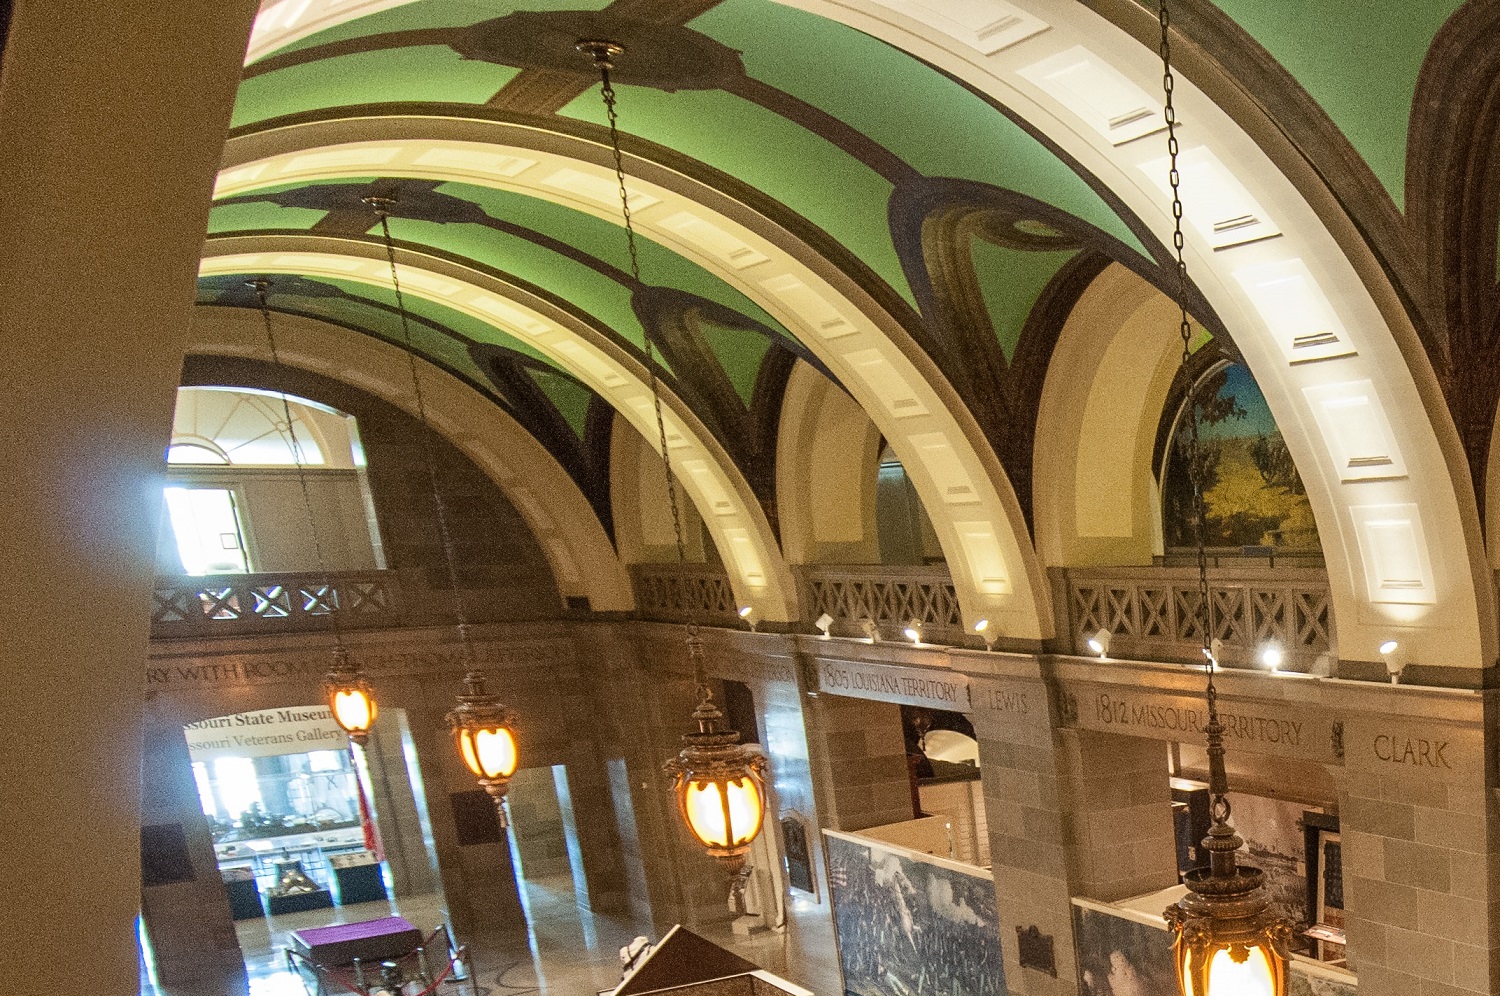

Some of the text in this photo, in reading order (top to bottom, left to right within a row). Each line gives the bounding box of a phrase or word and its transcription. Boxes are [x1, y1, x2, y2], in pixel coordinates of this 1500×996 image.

[176, 663, 239, 681] WITH
[824, 664, 850, 689] 1805
[850, 670, 901, 695] LOUISIANA
[901, 677, 958, 702] TERRITORY
[988, 689, 1030, 713] LEWIS
[235, 711, 274, 727] State
[1095, 693, 1303, 746] 1812 MISSOURI ERRITORY
[233, 732, 293, 748] Veterans
[296, 727, 341, 742] Gallery
[1374, 734, 1452, 769] CLARK
